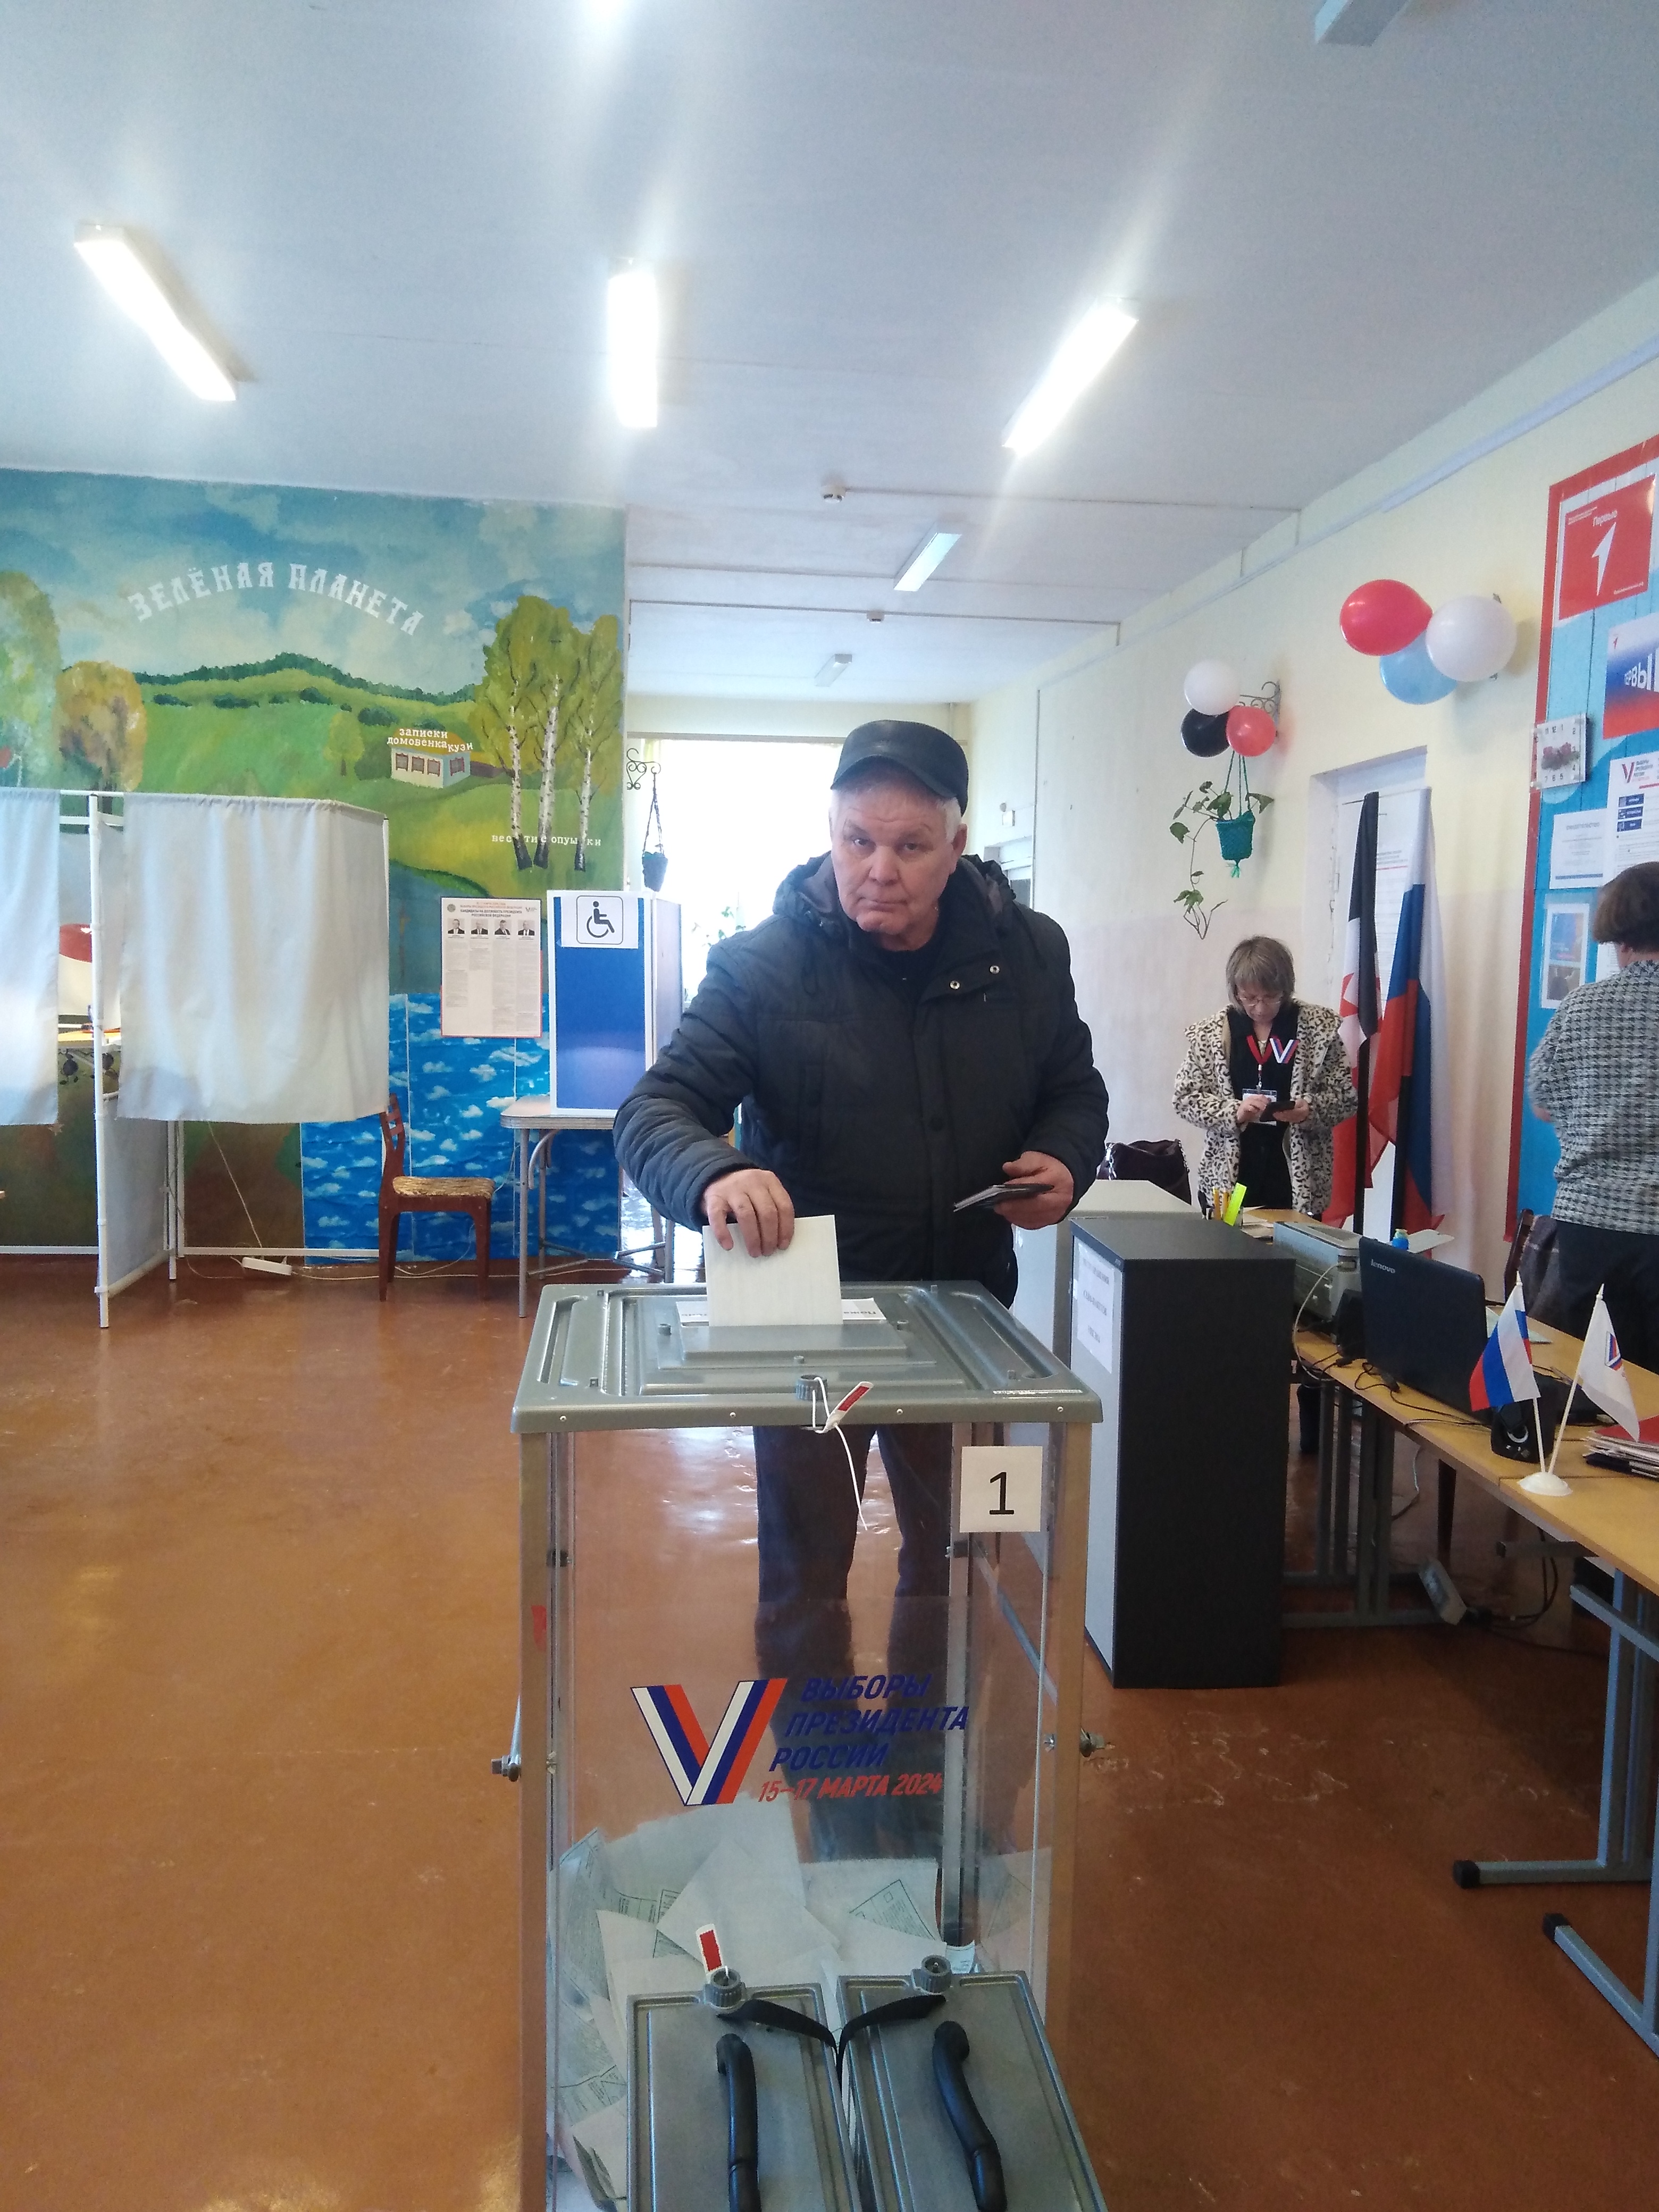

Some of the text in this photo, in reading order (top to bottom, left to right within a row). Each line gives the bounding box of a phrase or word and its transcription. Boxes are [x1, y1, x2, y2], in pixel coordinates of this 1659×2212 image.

[128, 562, 424, 635] ЗЕЛЁНАЯ ПЛАНЕТА
[399, 728, 448, 739] записки
[447, 742, 473, 752] кузи
[989, 1471, 1015, 1515] 1
[802, 1674, 930, 1702] ВЫБОРЫ
[787, 1706, 969, 1737] ПРЕЗИДЕНТА
[769, 1744, 886, 1772] РОССИИ
[818, 1776, 890, 1799] МАРТА
[891, 1773, 944, 1796] 2024
